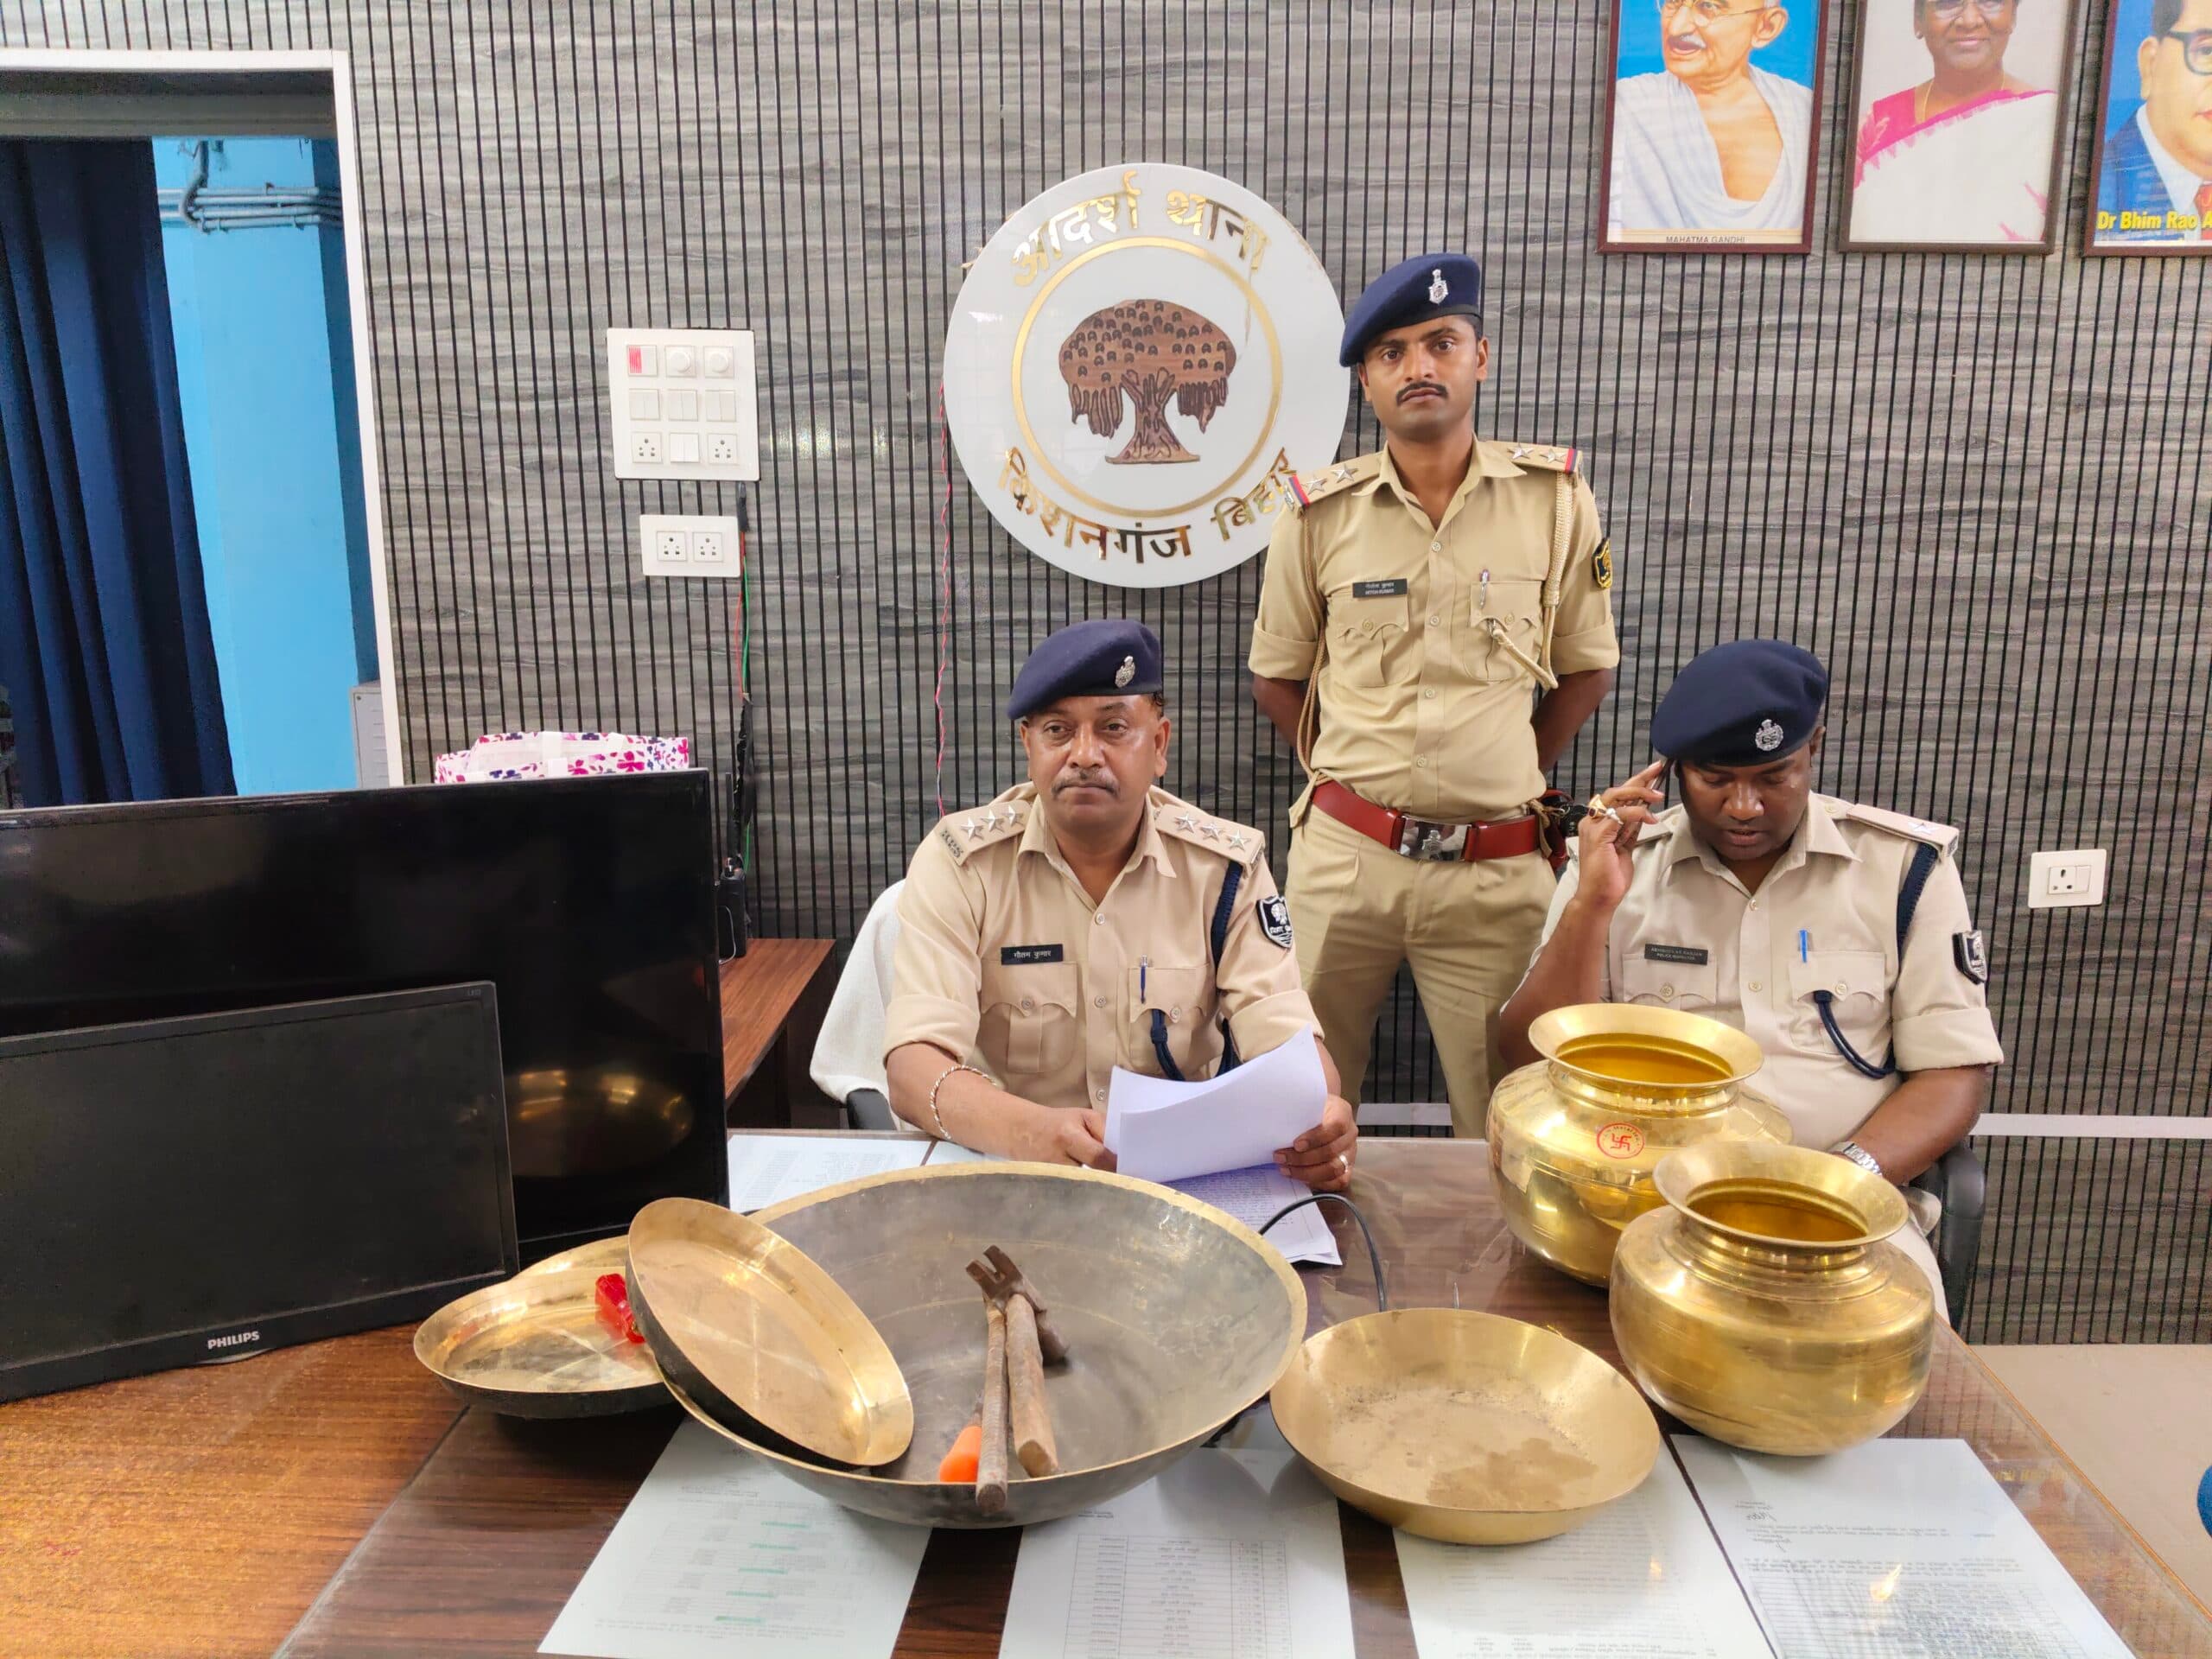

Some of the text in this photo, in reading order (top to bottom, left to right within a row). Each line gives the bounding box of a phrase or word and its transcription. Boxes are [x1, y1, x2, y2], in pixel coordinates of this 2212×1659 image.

[1012, 170, 1271, 287] आदर्श थाना
[2096, 210, 2117, 230] Dr
[2120, 210, 2162, 230] Bhim
[2165, 210, 2198, 230] Rao
[998, 447, 1192, 563] किशनगंज
[207, 1331, 260, 1350] PHILIPS
